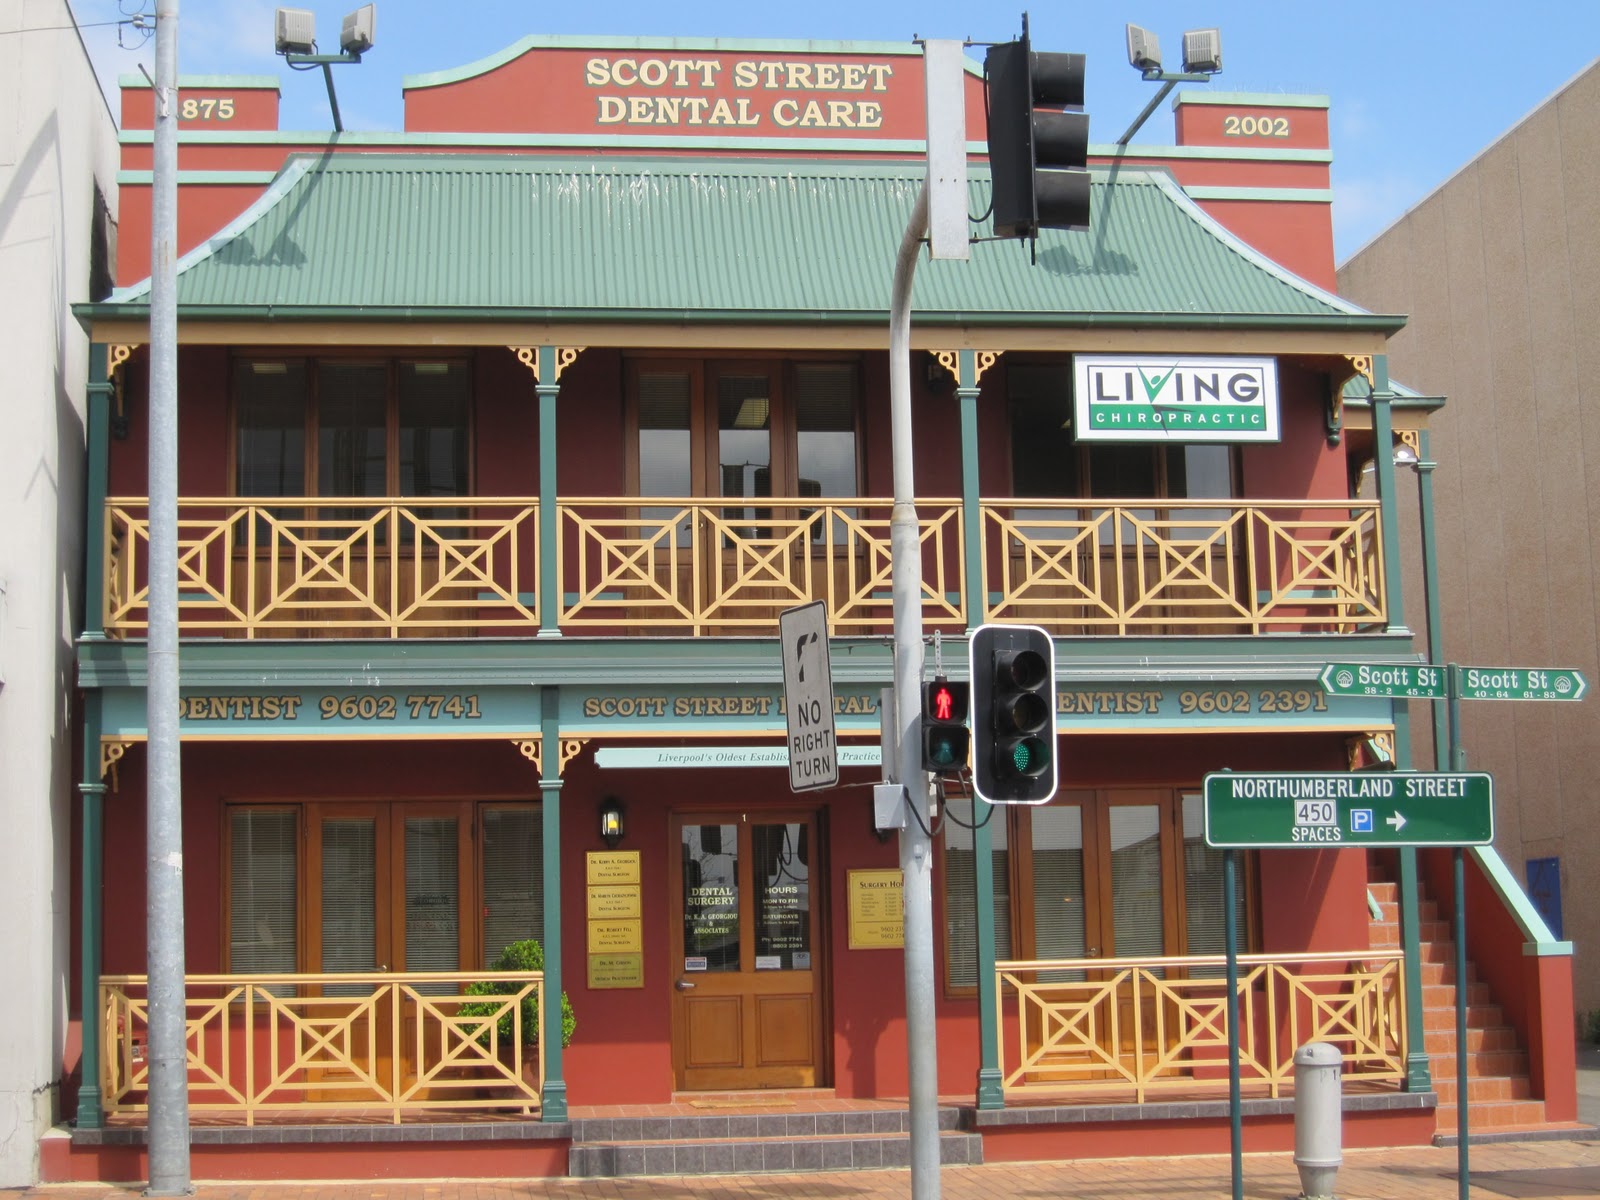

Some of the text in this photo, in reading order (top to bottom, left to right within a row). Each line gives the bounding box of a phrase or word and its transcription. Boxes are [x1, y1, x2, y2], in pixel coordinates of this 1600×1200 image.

[586, 58, 893, 91] SCOTT STREET
[181, 98, 235, 119] 875
[598, 96, 883, 128] DENTAL CARE
[1225, 116, 1289, 136] 2002
[1096, 360, 1260, 403] LIVING
[1096, 412, 1260, 424] CHIROPRACTIC
[1358, 665, 1437, 687] Scott St
[1467, 669, 1548, 689] Scott St
[1056, 690, 1328, 713] ENTIST 9602 2391
[1364, 687, 1378, 695] 38
[1387, 687, 1392, 695] 2
[1406, 688, 1418, 696] 45
[1428, 688, 1434, 696] 3
[1474, 690, 1487, 698] 40
[1523, 691, 1535, 699] 61
[1543, 691, 1556, 699] 83
[320, 695, 397, 719] 9602
[407, 695, 481, 718] 7741
[585, 697, 668, 716] SCOTT
[674, 696, 771, 715] STREET
[798, 700, 821, 727] NO
[793, 730, 830, 754] RIGHT
[658, 752, 790, 764] Liverpool's Oldest Establis
[796, 755, 831, 778] TURN
[842, 752, 881, 761] Practice
[1231, 778, 1467, 798] NORTHUMBERLAND STREET
[741, 813, 747, 822] 1
[1298, 803, 1333, 822] 450
[1354, 811, 1369, 829] P
[1291, 827, 1341, 842] SPACES
[692, 887, 733, 897] DENTAL
[764, 886, 798, 894] HOURS
[687, 896, 735, 906] SURGERY
